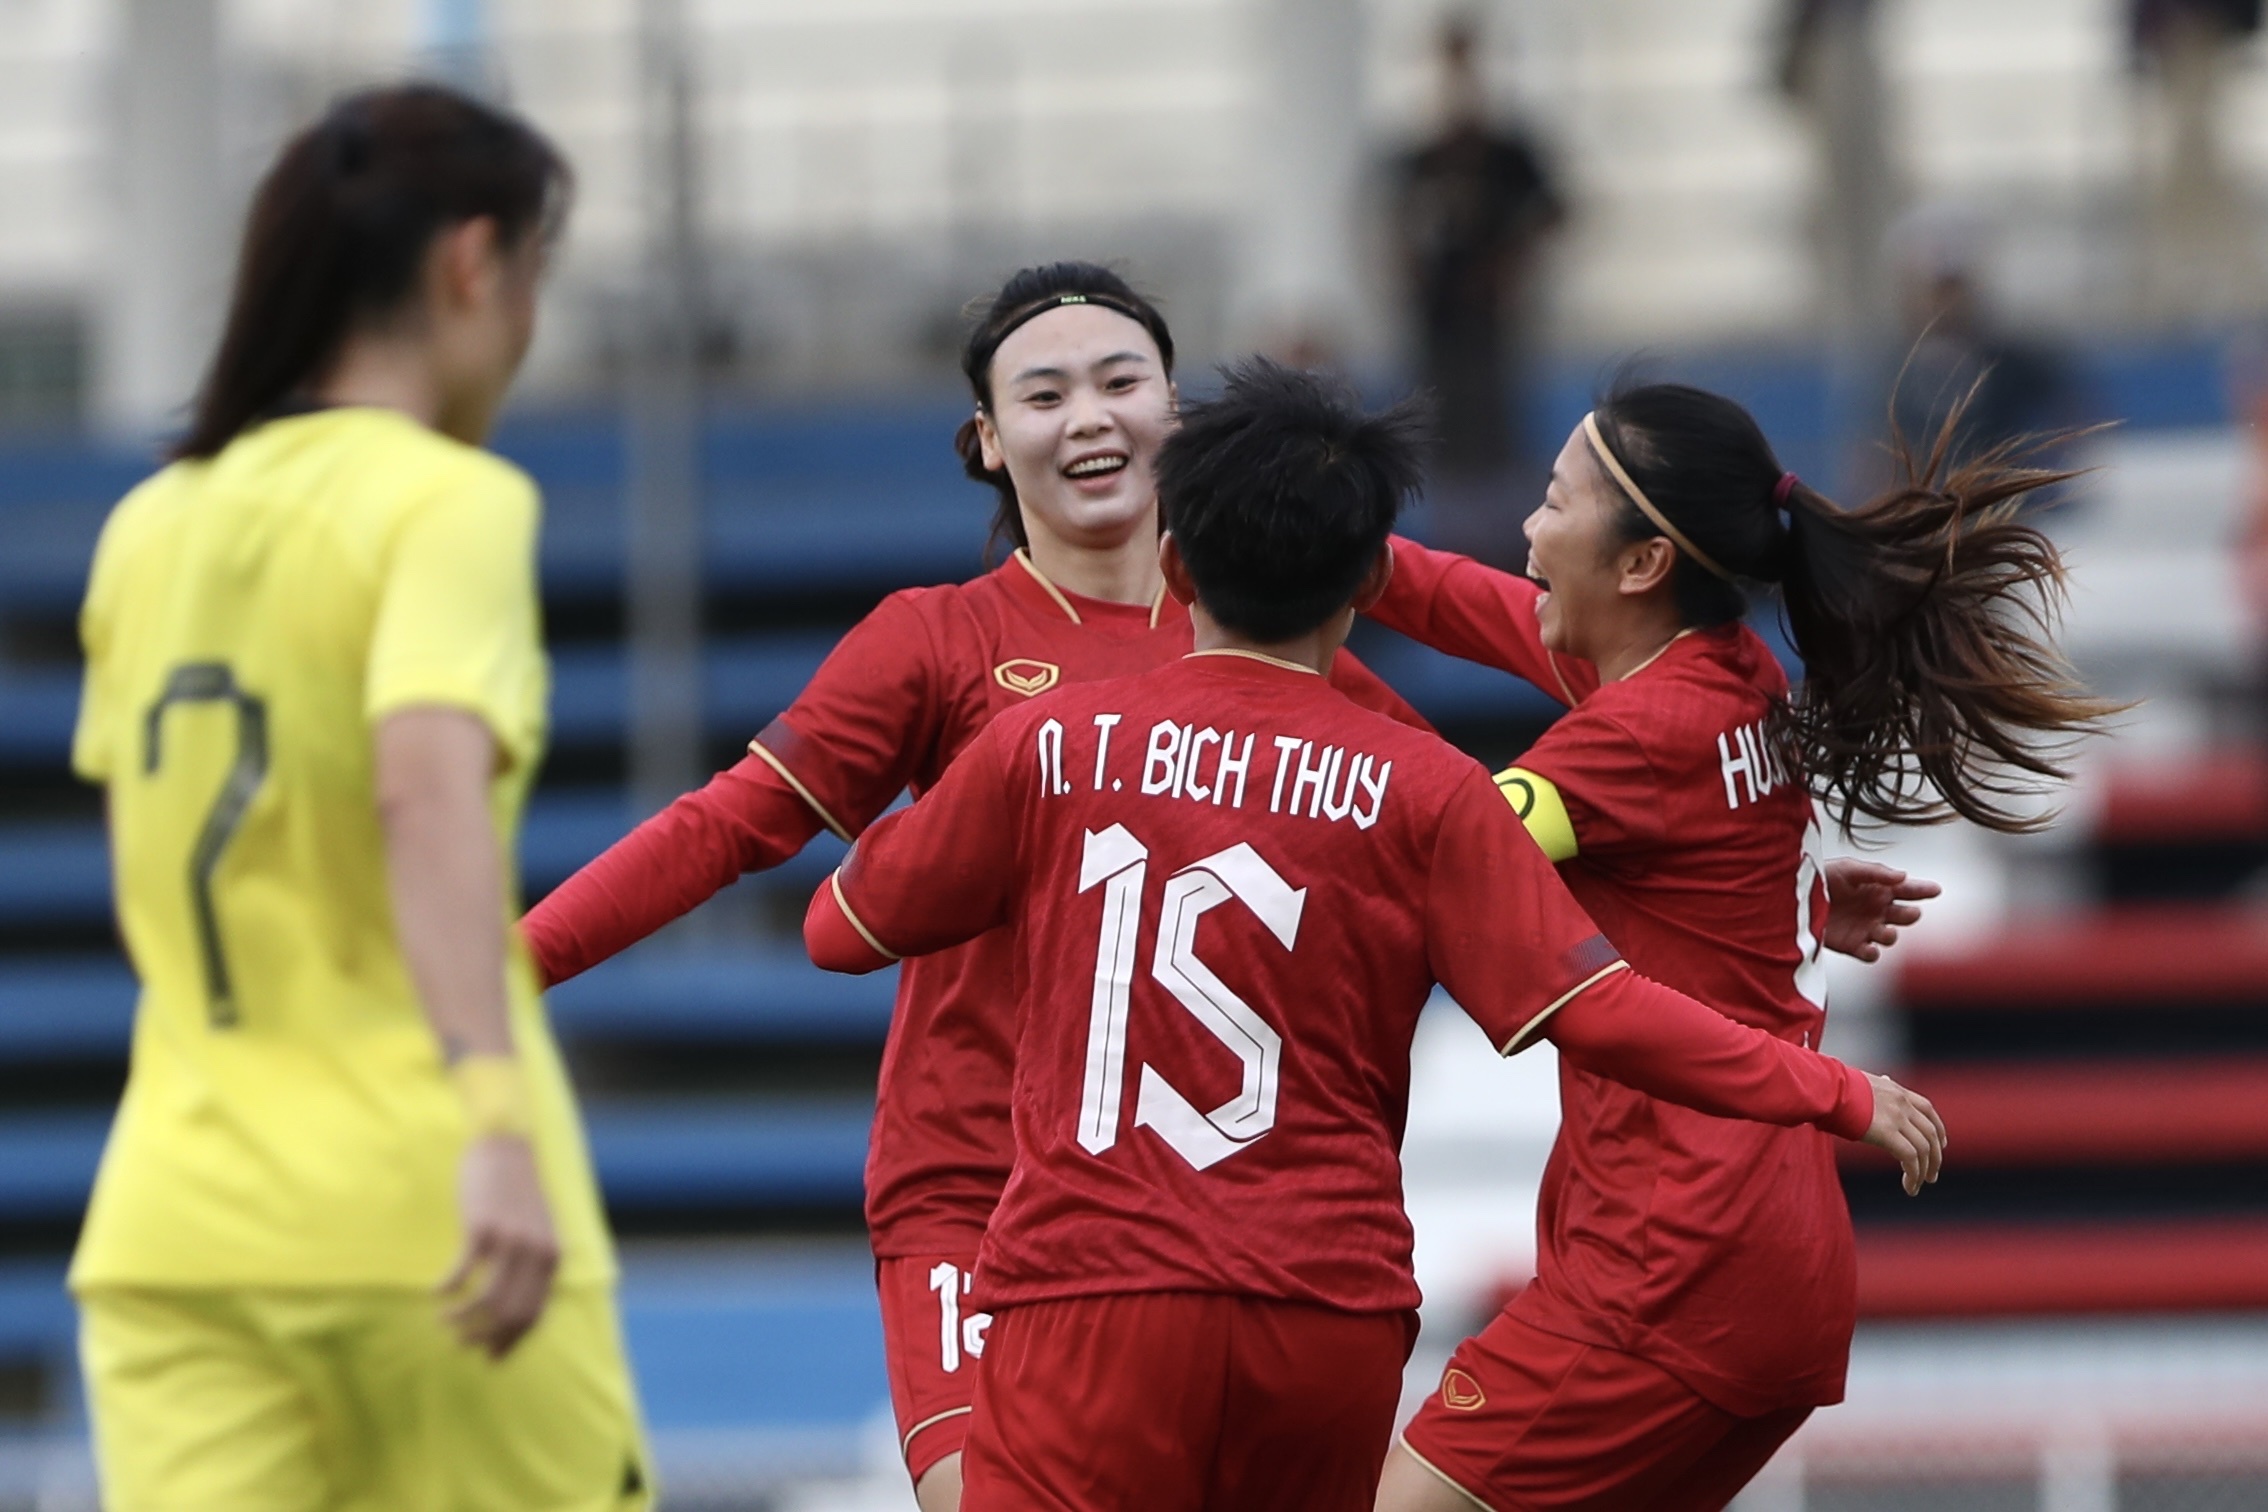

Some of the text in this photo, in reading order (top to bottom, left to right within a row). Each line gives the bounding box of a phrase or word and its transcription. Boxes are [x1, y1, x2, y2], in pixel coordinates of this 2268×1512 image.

[141, 659, 270, 1030] 7
[1093, 713, 1123, 792] T.
[1141, 719, 1255, 808] BICH
[1269, 735, 1392, 831] THUY
[1717, 718, 1791, 810] HU
[1077, 822, 1307, 1172] 15
